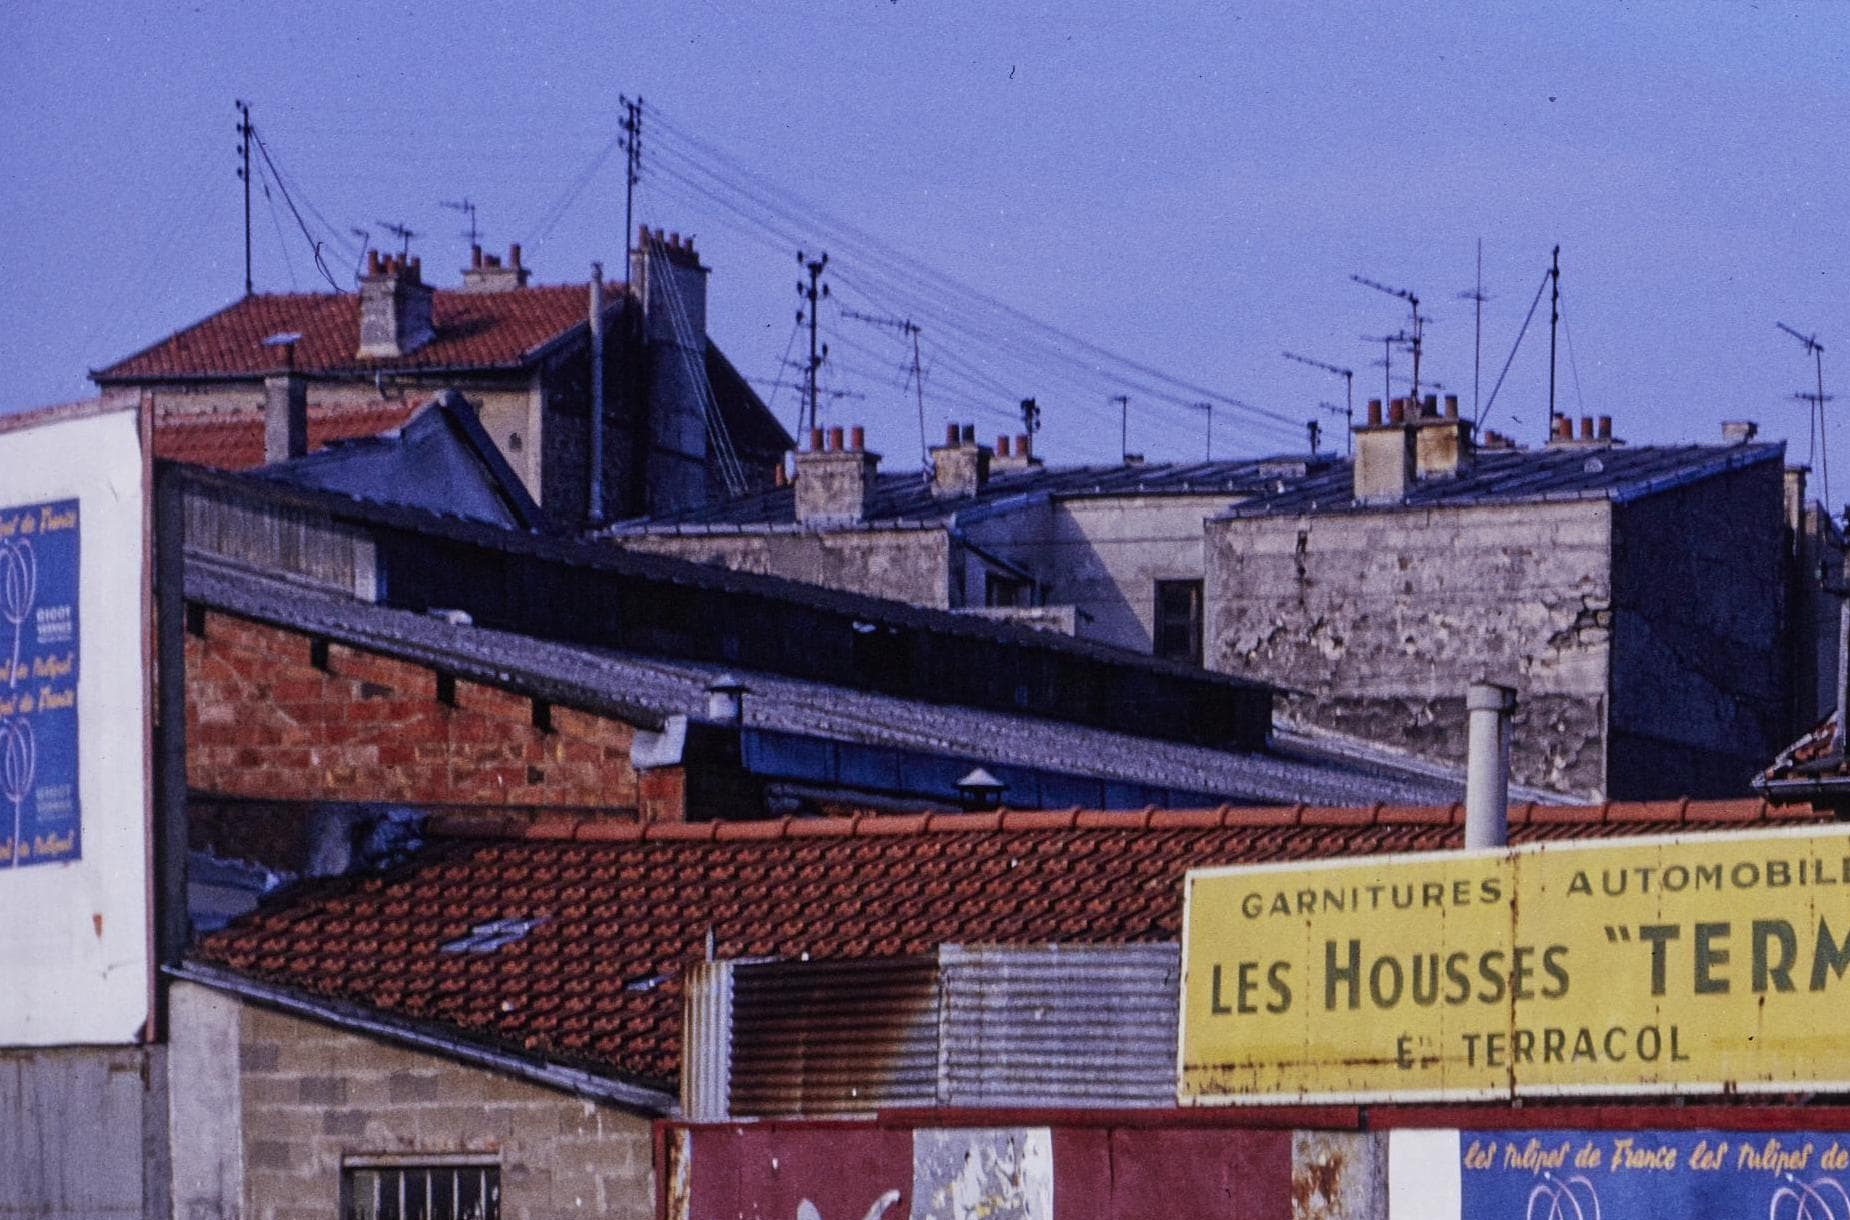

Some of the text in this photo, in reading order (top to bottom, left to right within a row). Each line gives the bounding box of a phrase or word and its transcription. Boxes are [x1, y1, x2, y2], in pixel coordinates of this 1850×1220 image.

[1241, 877, 1505, 920] GARNITURES
[1211, 960, 1291, 1015] LES
[1324, 938, 1570, 1011] HOUSSES
[1462, 1025, 1691, 1067] TERRACOL
[1574, 1140, 1600, 1169] de
[1610, 1138, 1677, 1172] France
[1820, 1141, 1849, 1170] de
